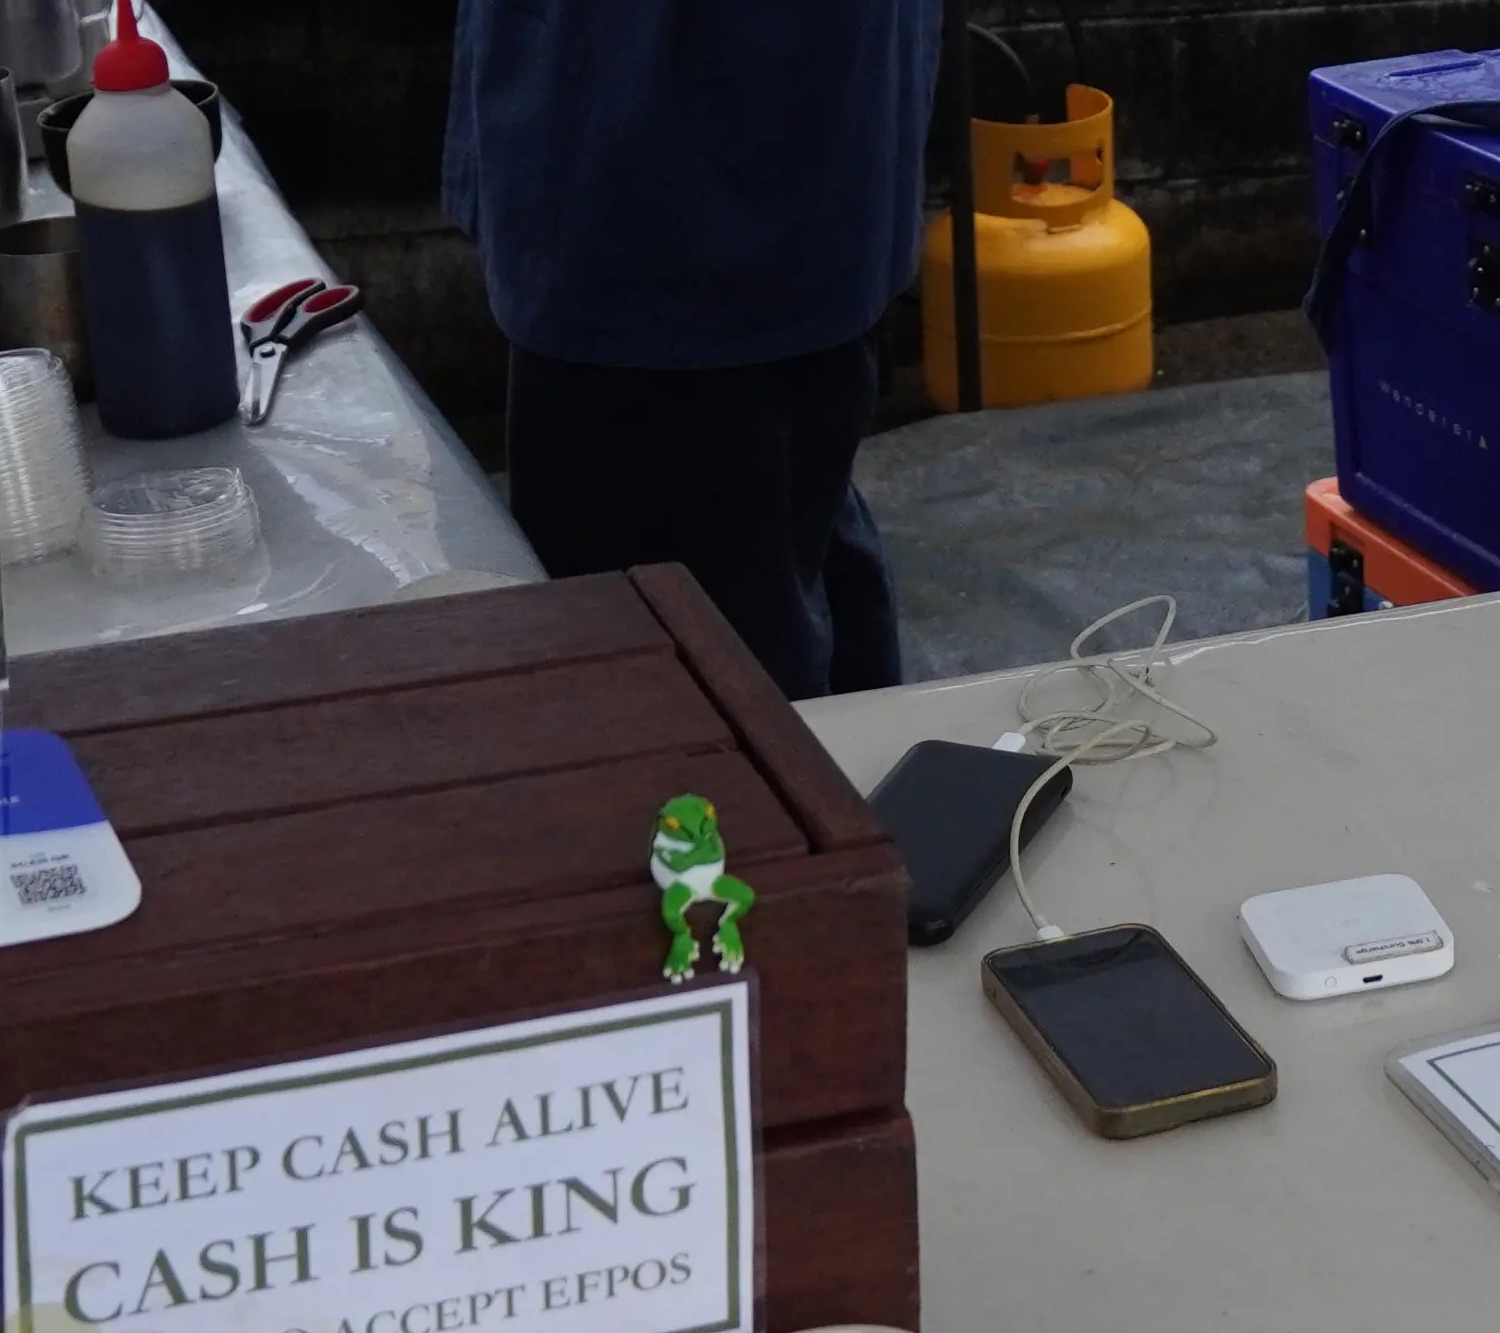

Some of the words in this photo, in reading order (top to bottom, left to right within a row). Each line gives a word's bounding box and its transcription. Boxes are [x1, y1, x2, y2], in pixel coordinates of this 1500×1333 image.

[68, 1145, 262, 1222] KEEP
[281, 1109, 463, 1181] CASH
[488, 1067, 689, 1146] ALIVE
[62, 1223, 321, 1326] CASH
[348, 1205, 426, 1274] IS
[455, 1156, 694, 1254] KING
[339, 1284, 526, 1333] ACCEPT
[543, 1255, 692, 1311] EFPOS
